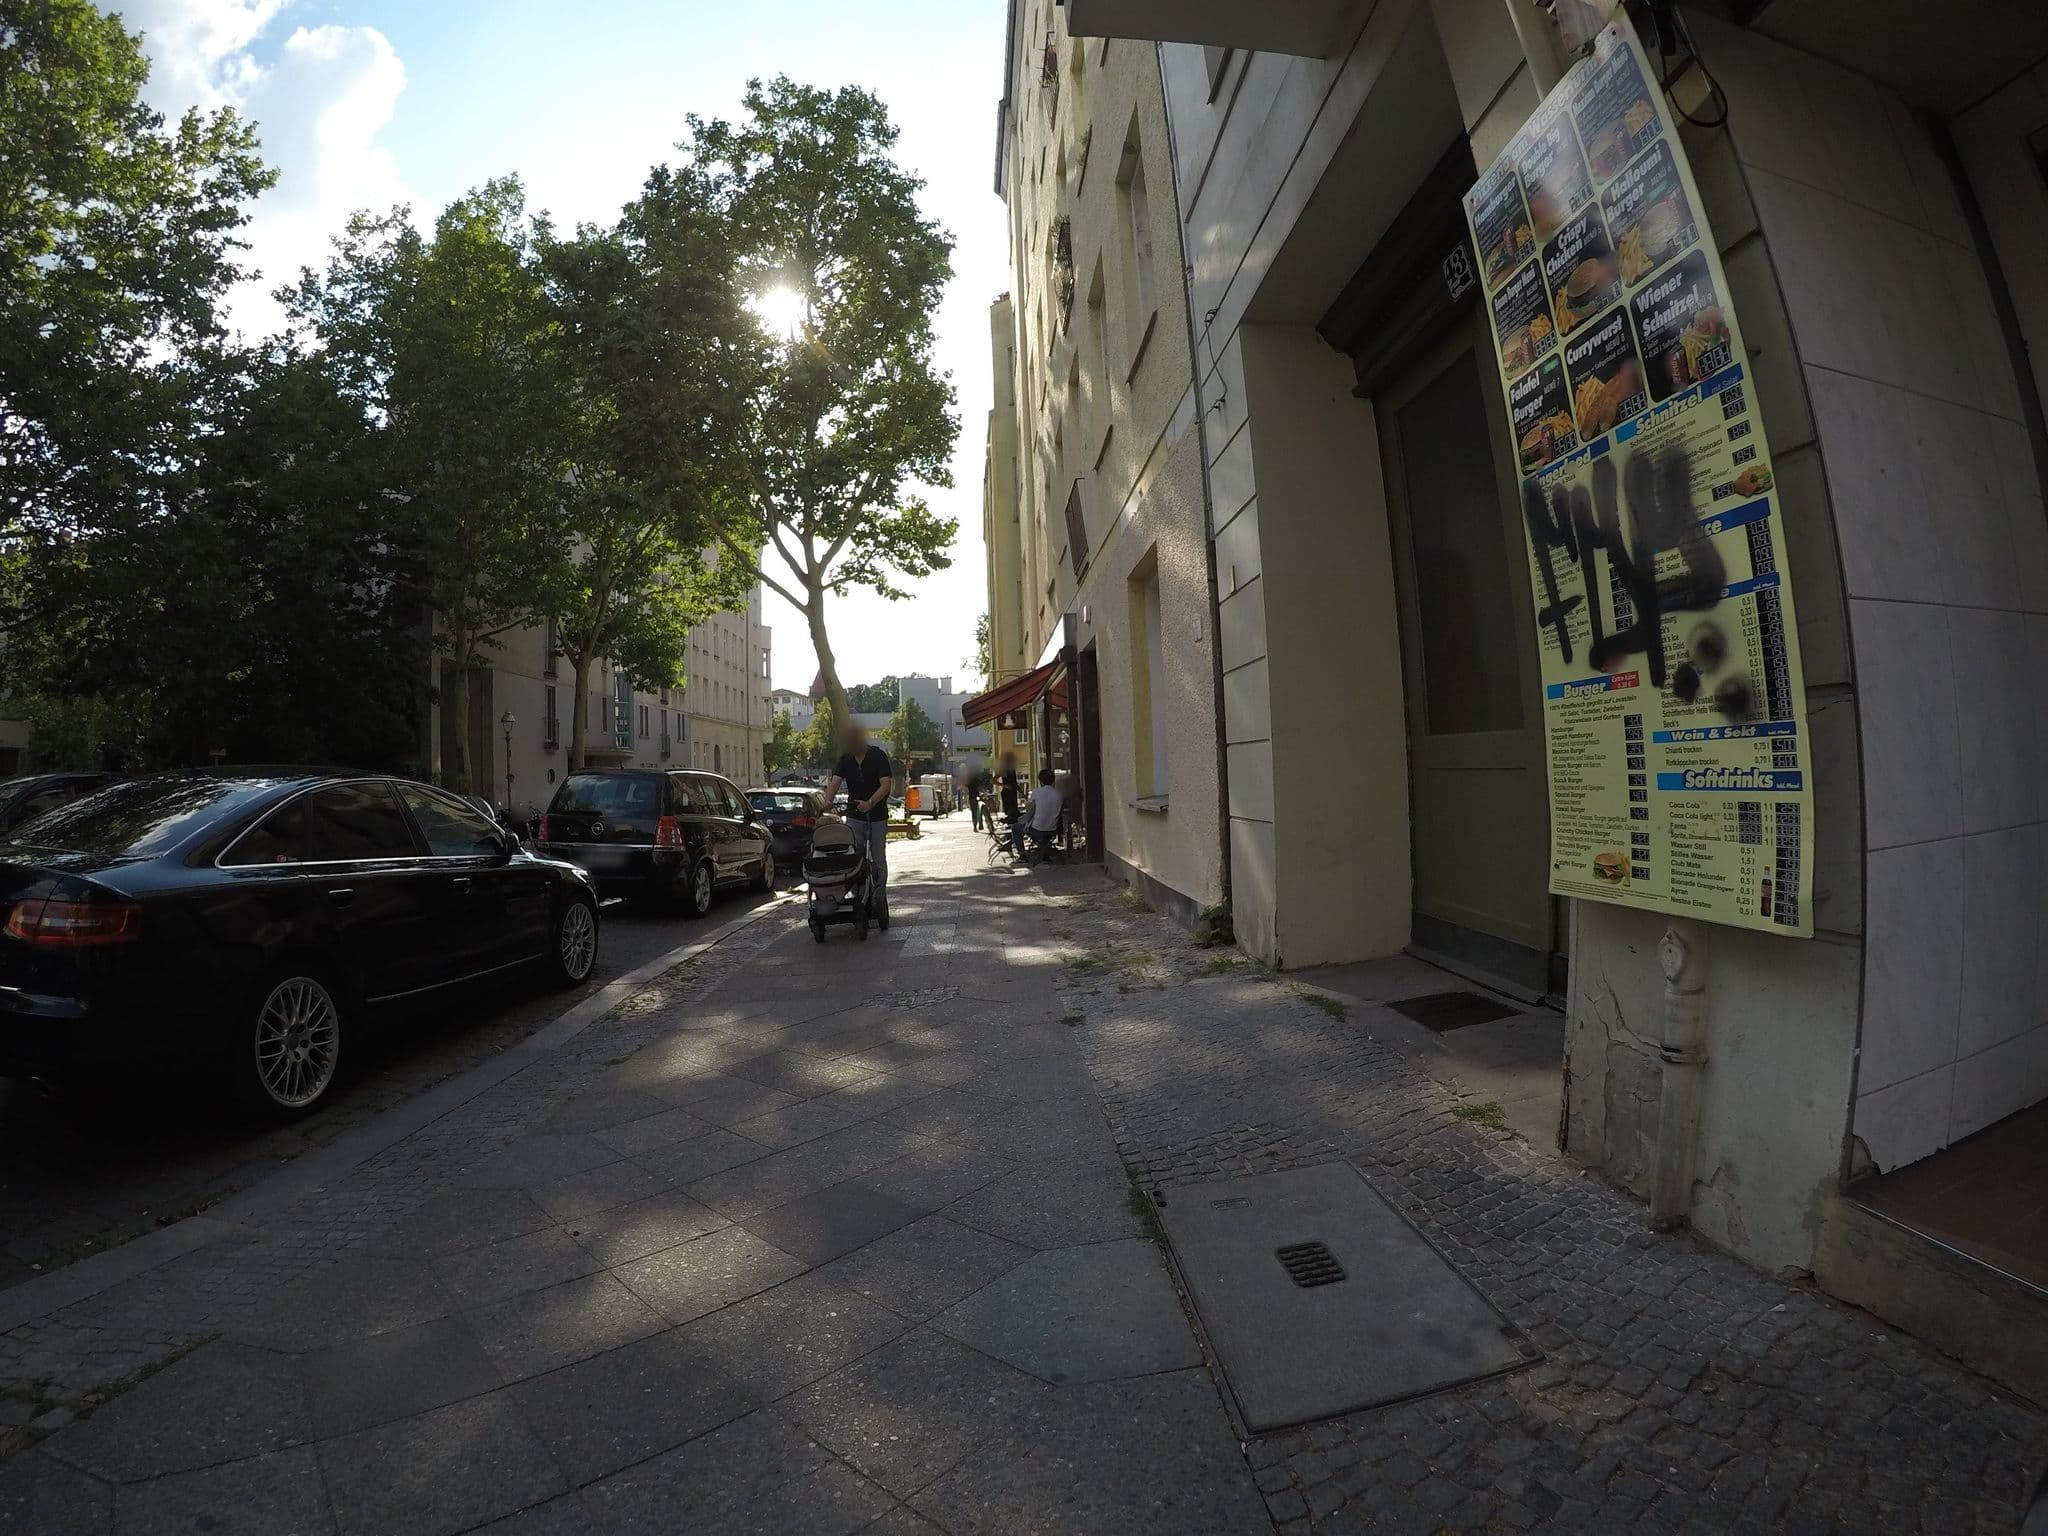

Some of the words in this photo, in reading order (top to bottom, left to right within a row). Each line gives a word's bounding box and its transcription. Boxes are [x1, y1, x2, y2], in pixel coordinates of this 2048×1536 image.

[1521, 140, 1547, 175] Double
[1524, 151, 1553, 187] Burger
[1610, 143, 1663, 202] Halloumi
[1475, 176, 1516, 228] Hamburger
[1606, 182, 1645, 224] Burger
[1558, 216, 1588, 249] Crispy
[1546, 240, 1584, 276] Chicken
[1636, 272, 1683, 313] Wiener
[1642, 283, 1700, 338] Schnitzel
[1566, 314, 1624, 366] Currywurst
[1510, 370, 1541, 404] Falafel
[1513, 395, 1544, 424] Burger
[1635, 387, 1703, 436] Schnitzel
[1564, 682, 1606, 700] Burger
[1671, 730, 1704, 741] Wein
[1708, 729, 1719, 738] &
[1724, 726, 1756, 738] Sekt
[1685, 768, 1774, 788] Softdrinks
[1686, 802, 1700, 810] Cola
[1686, 812, 1699, 820] Cola
[1700, 812, 1714, 821] light
[1670, 822, 1687, 830] Fanta
[1670, 842, 1694, 850] Wasser
[1670, 850, 1690, 858] Stilles
[1690, 852, 1714, 860] Wasser
[1670, 870, 1696, 878] Bionade
[1697, 873, 1726, 882] Holunder
[1670, 878, 1696, 887] Bionade
[1670, 887, 1688, 896] Ayran
